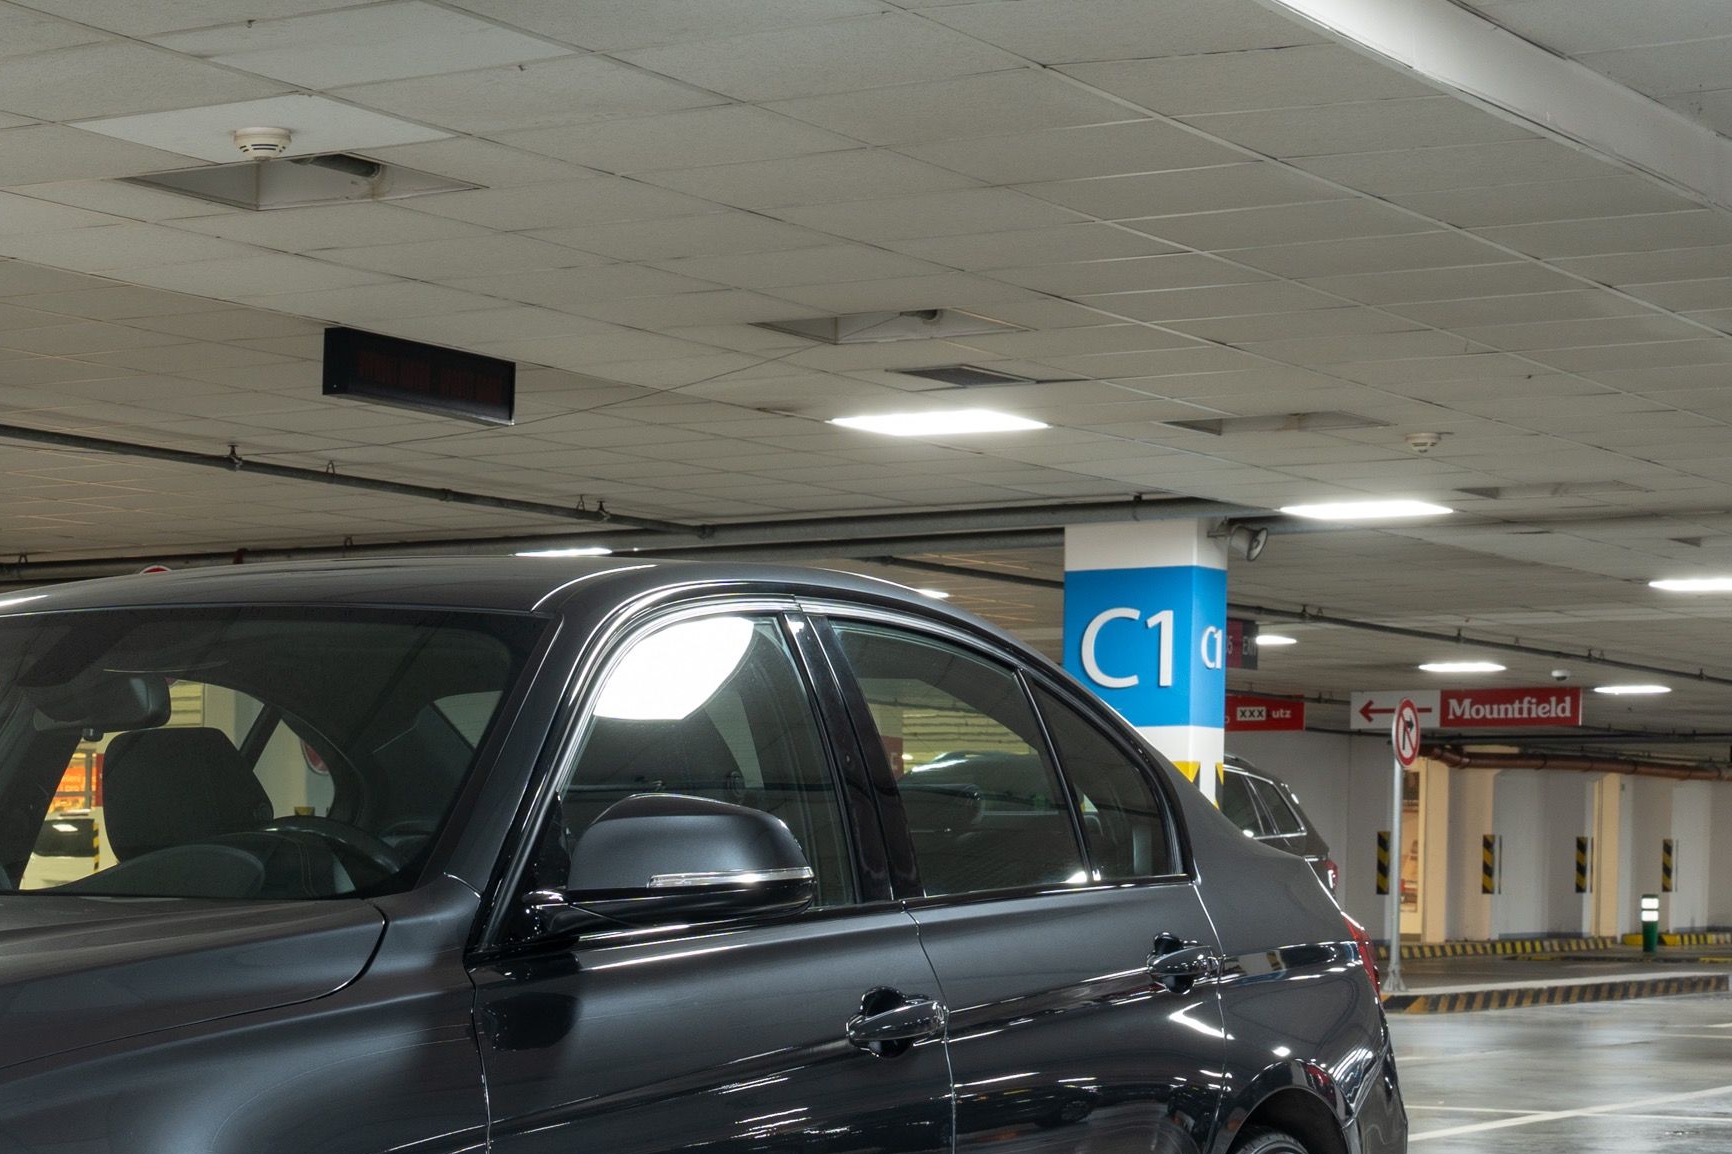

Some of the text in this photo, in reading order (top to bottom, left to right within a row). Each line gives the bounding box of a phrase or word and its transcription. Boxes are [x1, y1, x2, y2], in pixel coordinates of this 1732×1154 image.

[1080, 607, 1176, 690] C1
[1200, 625, 1223, 670] C1
[1447, 695, 1572, 720] Mountfield
